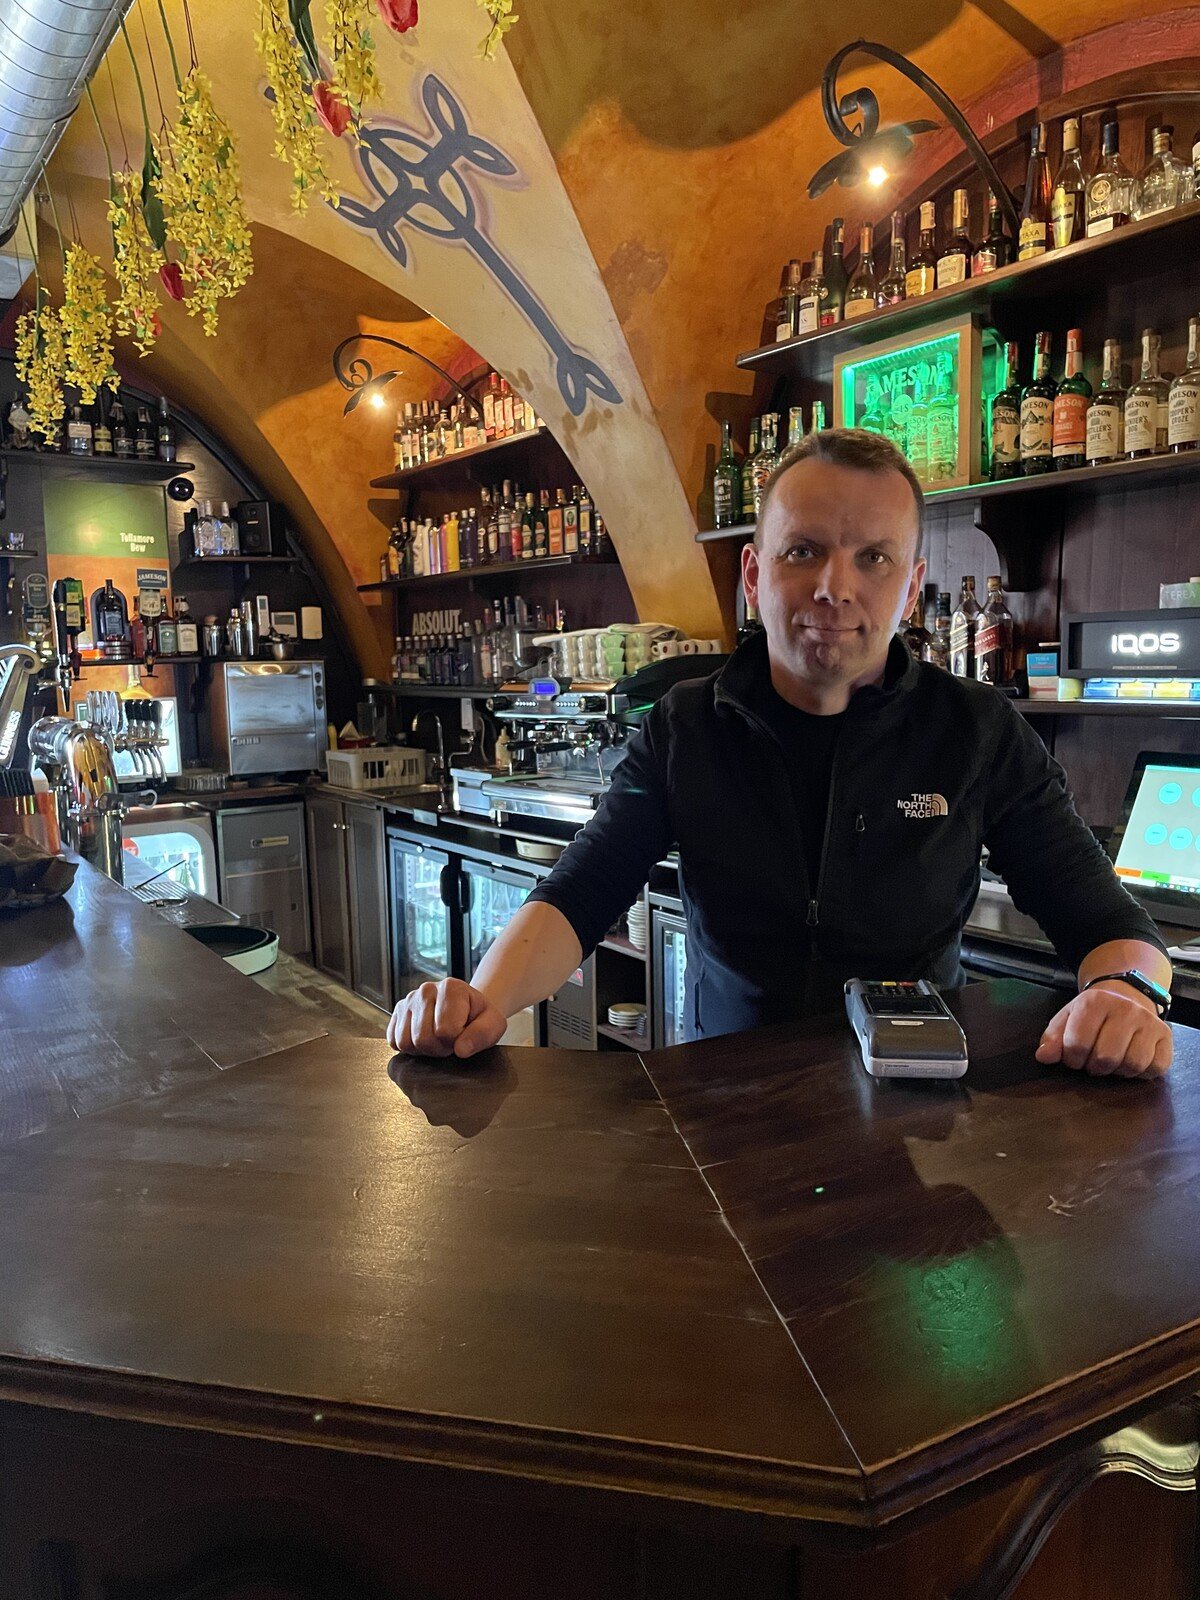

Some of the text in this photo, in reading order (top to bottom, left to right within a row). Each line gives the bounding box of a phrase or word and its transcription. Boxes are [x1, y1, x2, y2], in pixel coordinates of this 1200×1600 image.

[120, 532, 155, 544] Tullamore
[130, 542, 146, 553] Dew
[138, 573, 166, 581] JAMESON
[1165, 590, 1196, 600] TEREA
[1111, 633, 1180, 656] IQOS
[911, 793, 933, 802] THE
[897, 800, 932, 810] NORTH
[905, 809, 931, 818] FACE
